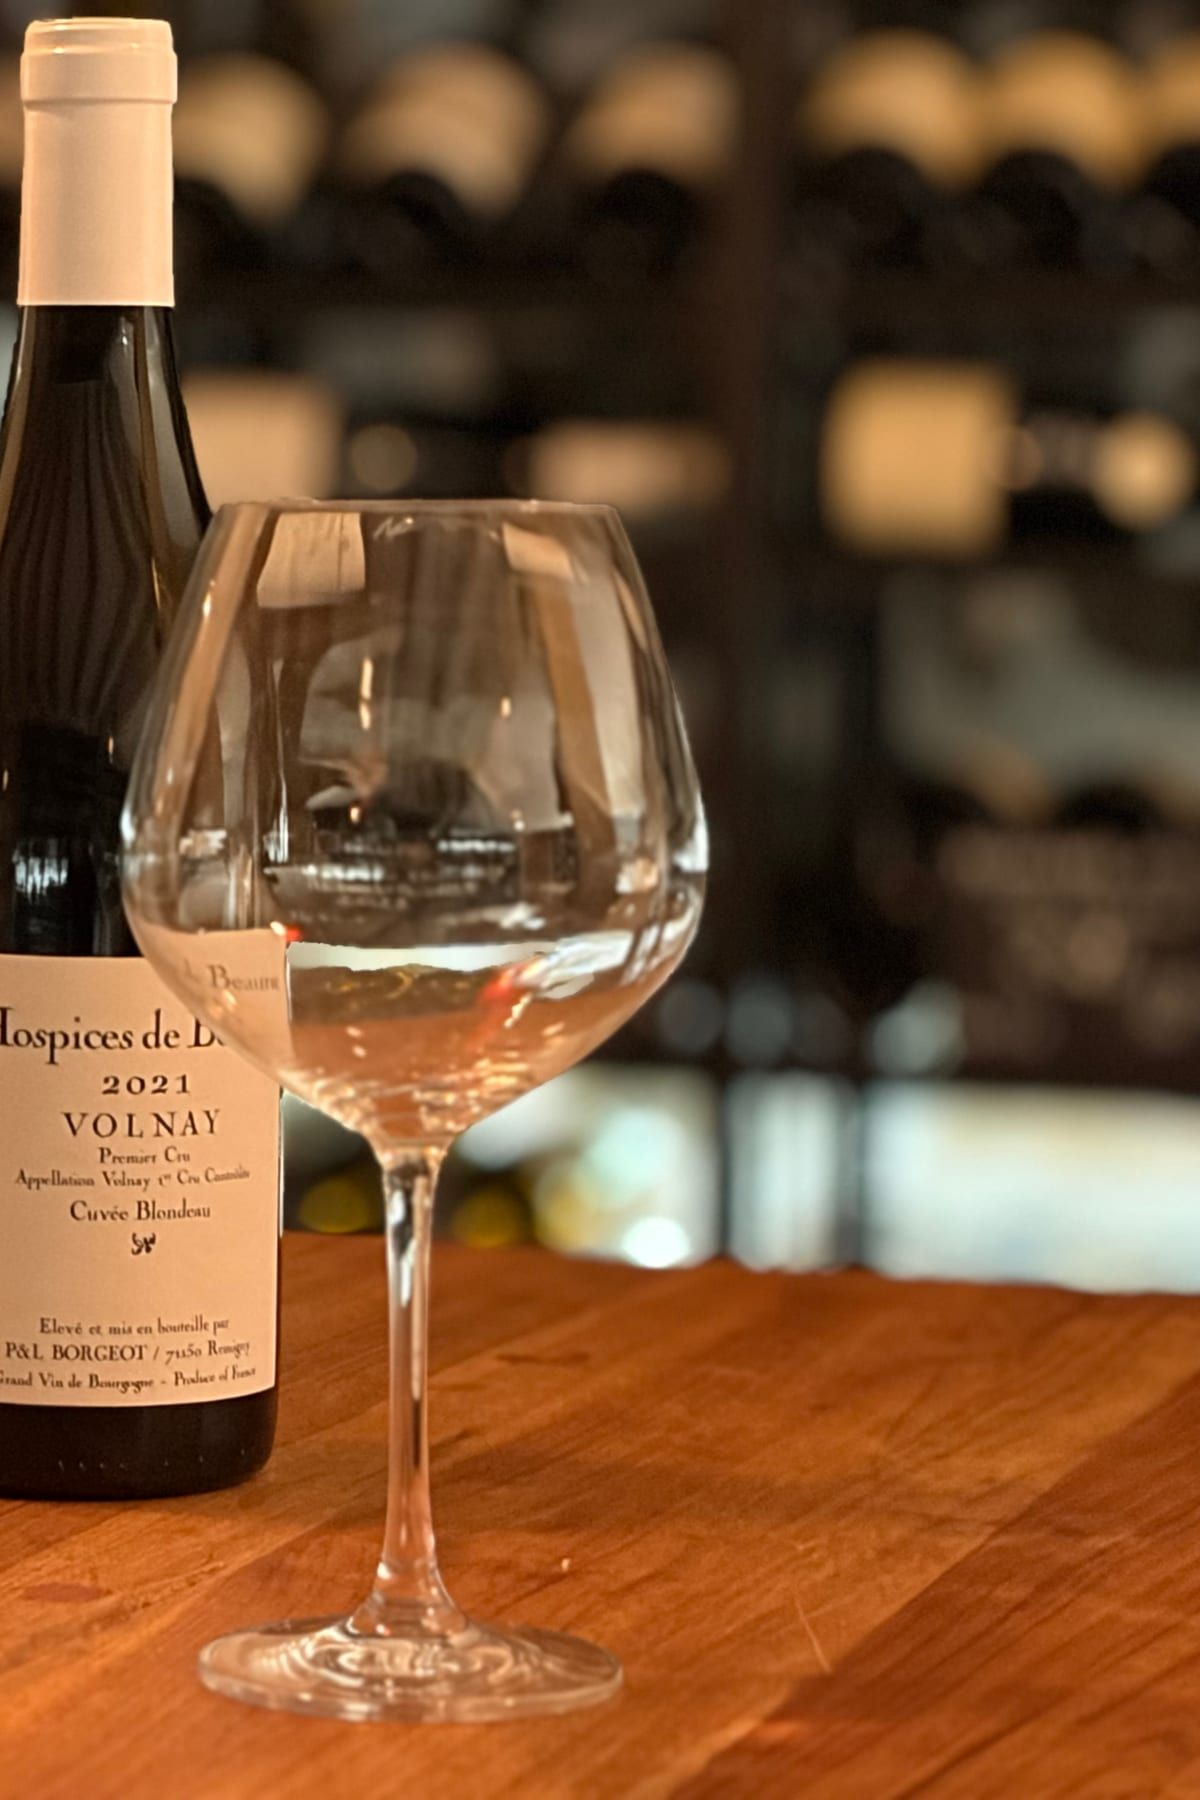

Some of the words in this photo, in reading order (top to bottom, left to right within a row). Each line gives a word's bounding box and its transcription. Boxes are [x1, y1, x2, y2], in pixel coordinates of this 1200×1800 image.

[142, 1008, 181, 1050] de
[102, 1074, 191, 1096] 2021
[62, 1109, 221, 1139] VOLNAY
[98, 1147, 158, 1165] Premier
[164, 1145, 191, 1163] Cru
[15, 1168, 95, 1191] Appellation
[102, 1170, 151, 1192] Volnay
[177, 1170, 201, 1185] Cru
[70, 1200, 129, 1222] Cuvée
[136, 1197, 211, 1221] Blondeau
[40, 1317, 83, 1336] Elevé
[89, 1322, 102, 1336] et
[109, 1320, 133, 1336] mis
[136, 1324, 153, 1335] en
[157, 1315, 209, 1334] bouteille
[213, 1319, 230, 1336] par
[5, 1341, 44, 1360] P&L
[52, 1343, 148, 1362] BORGEOT
[165, 1343, 202, 1365] 71150
[38, 1371, 64, 1388] Vin
[68, 1373, 82, 1389] de
[89, 1373, 154, 1394] Bourgogne
[174, 1370, 215, 1386] Produce
[219, 1367, 230, 1382] of
